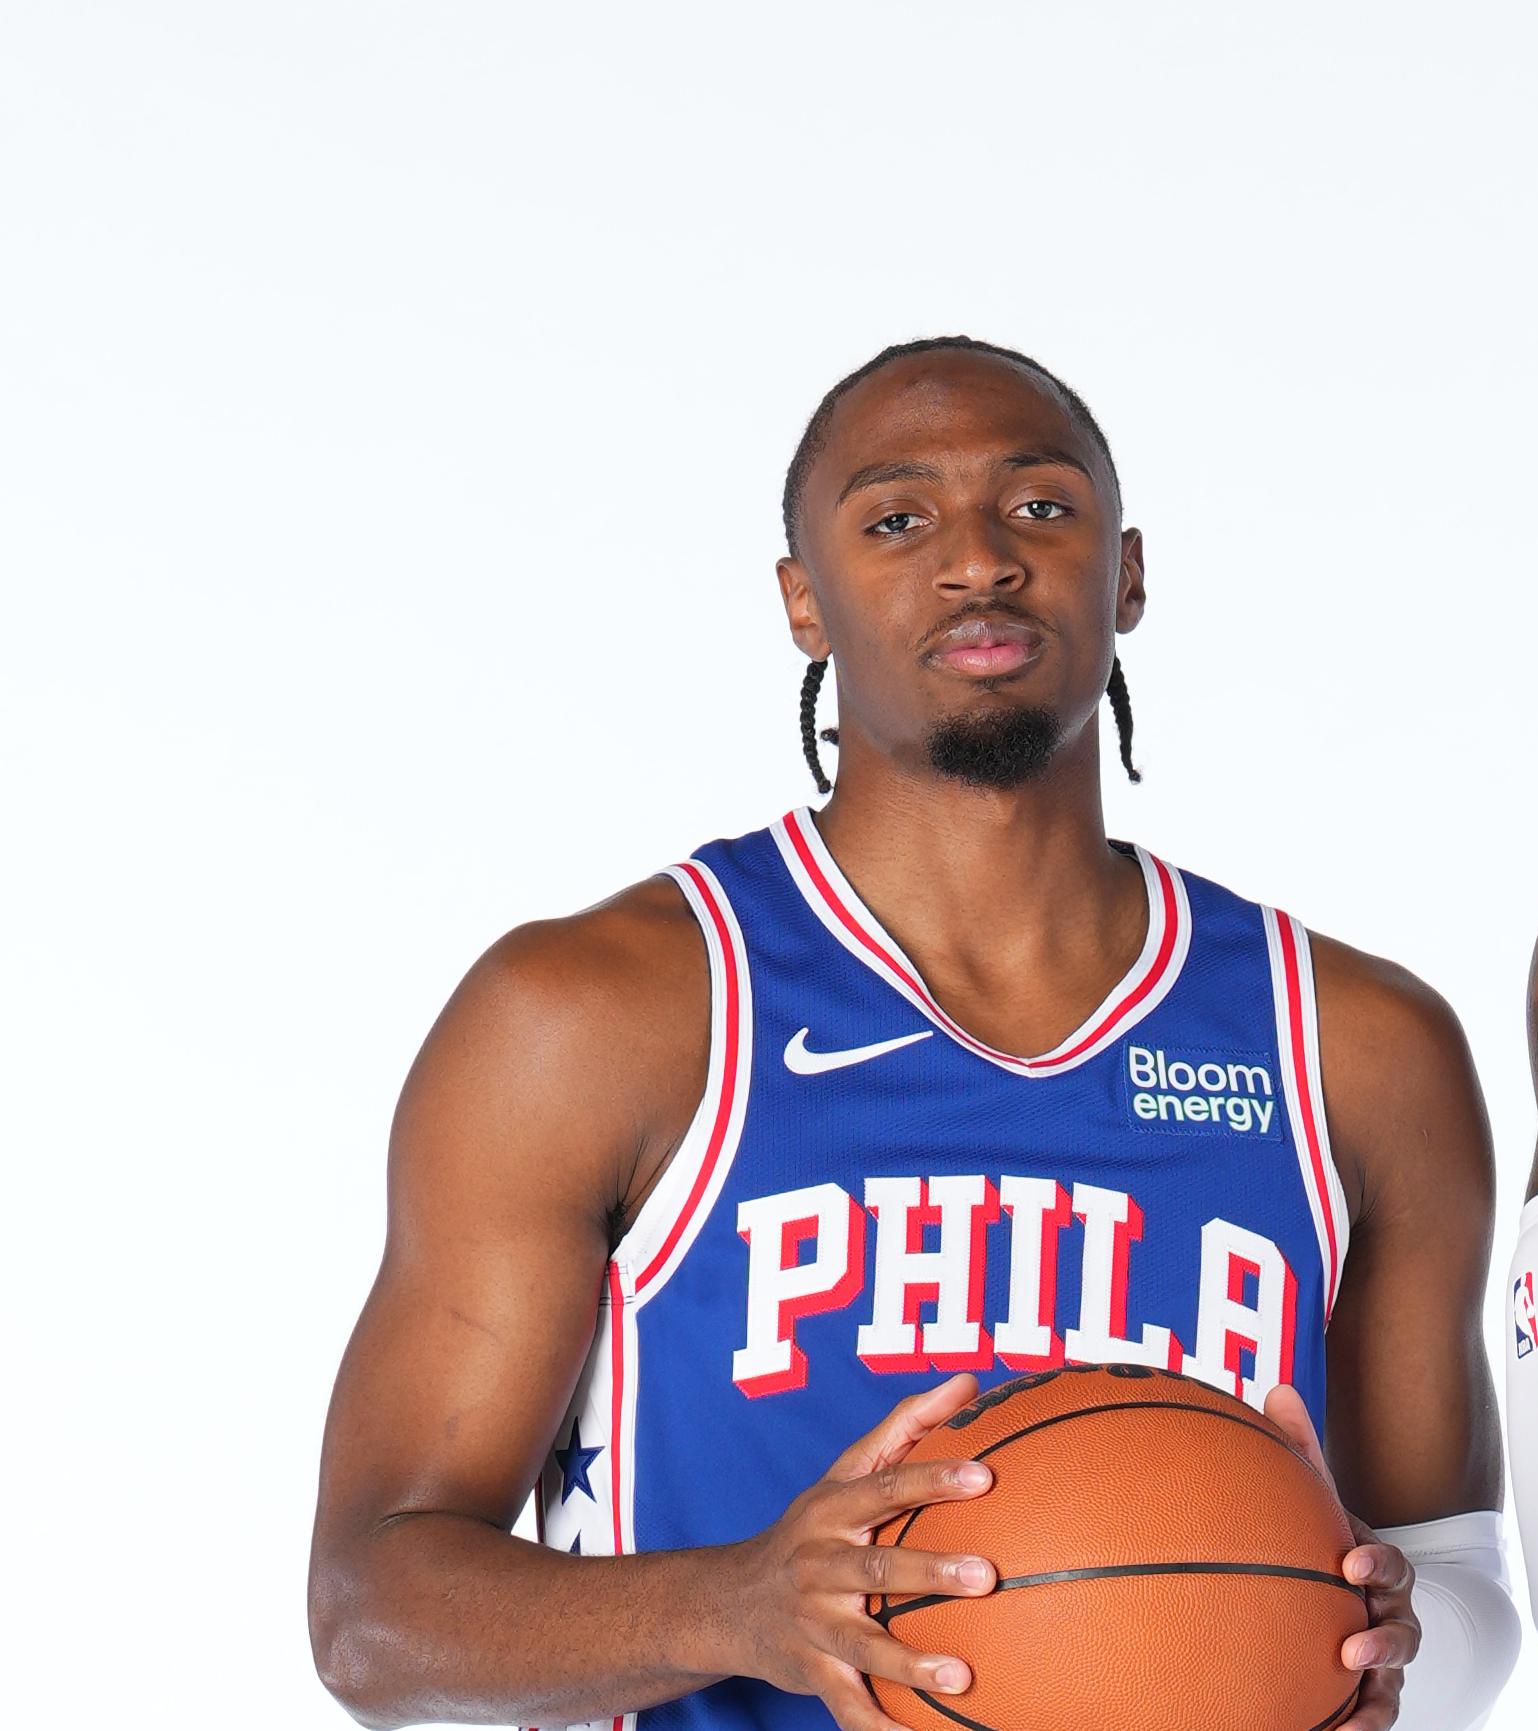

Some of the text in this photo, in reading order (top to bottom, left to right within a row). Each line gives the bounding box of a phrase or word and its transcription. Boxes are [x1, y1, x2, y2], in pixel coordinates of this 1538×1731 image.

[1129, 1046, 1273, 1095] Bloom
[1133, 1092, 1274, 1133] energy
[732, 1174, 1298, 1414] PHILA
